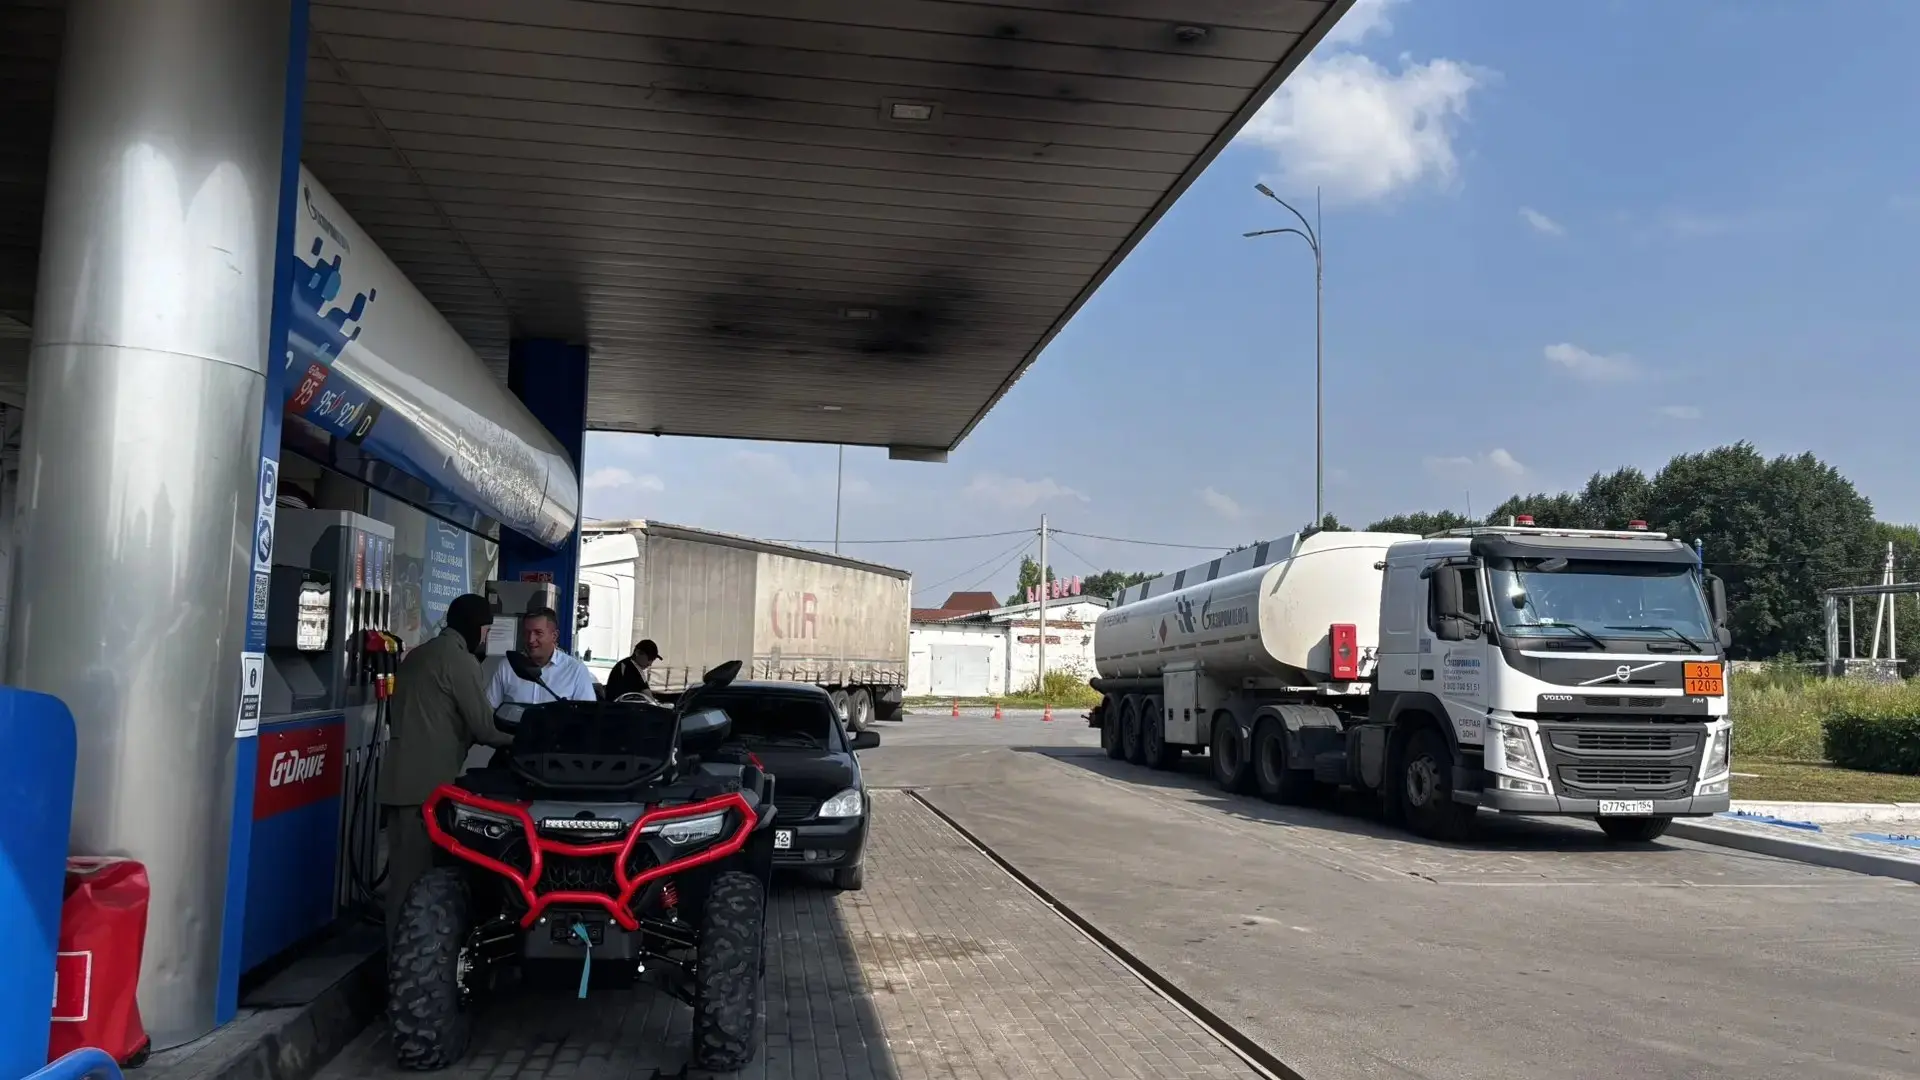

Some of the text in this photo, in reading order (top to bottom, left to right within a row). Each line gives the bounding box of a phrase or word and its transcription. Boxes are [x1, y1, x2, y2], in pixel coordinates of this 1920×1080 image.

[295, 378, 319, 405] 95
[334, 402, 356, 427] 92
[356, 415, 372, 437] D
[1696, 665, 1710, 677] 33
[1690, 680, 1718, 692] 1203
